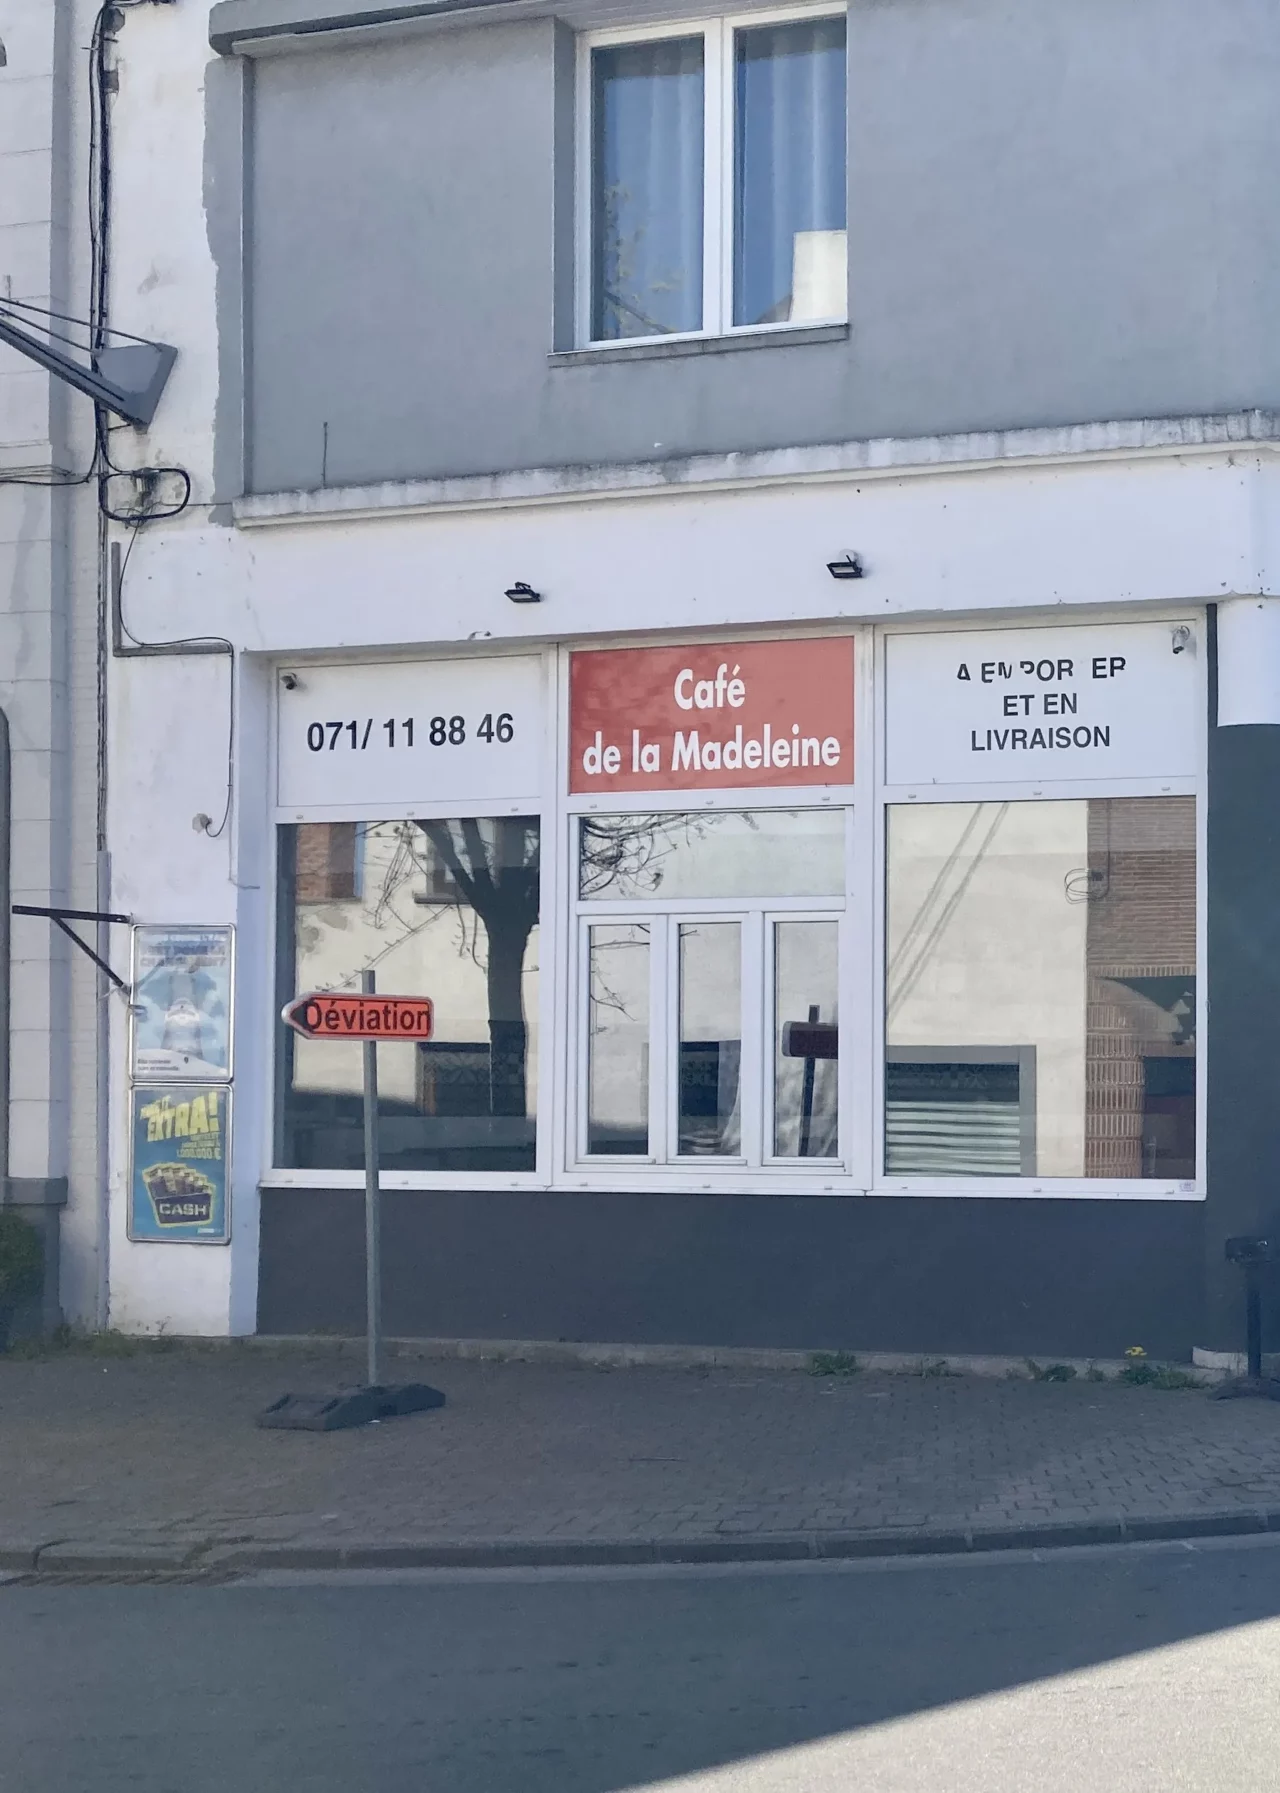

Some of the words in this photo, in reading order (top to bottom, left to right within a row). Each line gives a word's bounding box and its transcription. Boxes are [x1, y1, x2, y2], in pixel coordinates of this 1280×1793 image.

[674, 663, 746, 710] Café
[956, 663, 971, 681] A
[1003, 694, 1035, 716] ET
[1043, 692, 1077, 715] EN
[306, 718, 374, 752] 071/
[383, 717, 414, 748] 11
[429, 716, 466, 746] 88
[476, 712, 514, 744] 46
[971, 725, 1110, 751] LIVRAISON
[583, 730, 621, 775] de
[632, 729, 660, 773] la
[671, 723, 841, 772] Madeleine
[305, 1000, 430, 1031] Déviation
[147, 1091, 220, 1142] EXTRA!
[159, 1203, 207, 1216] CASH
